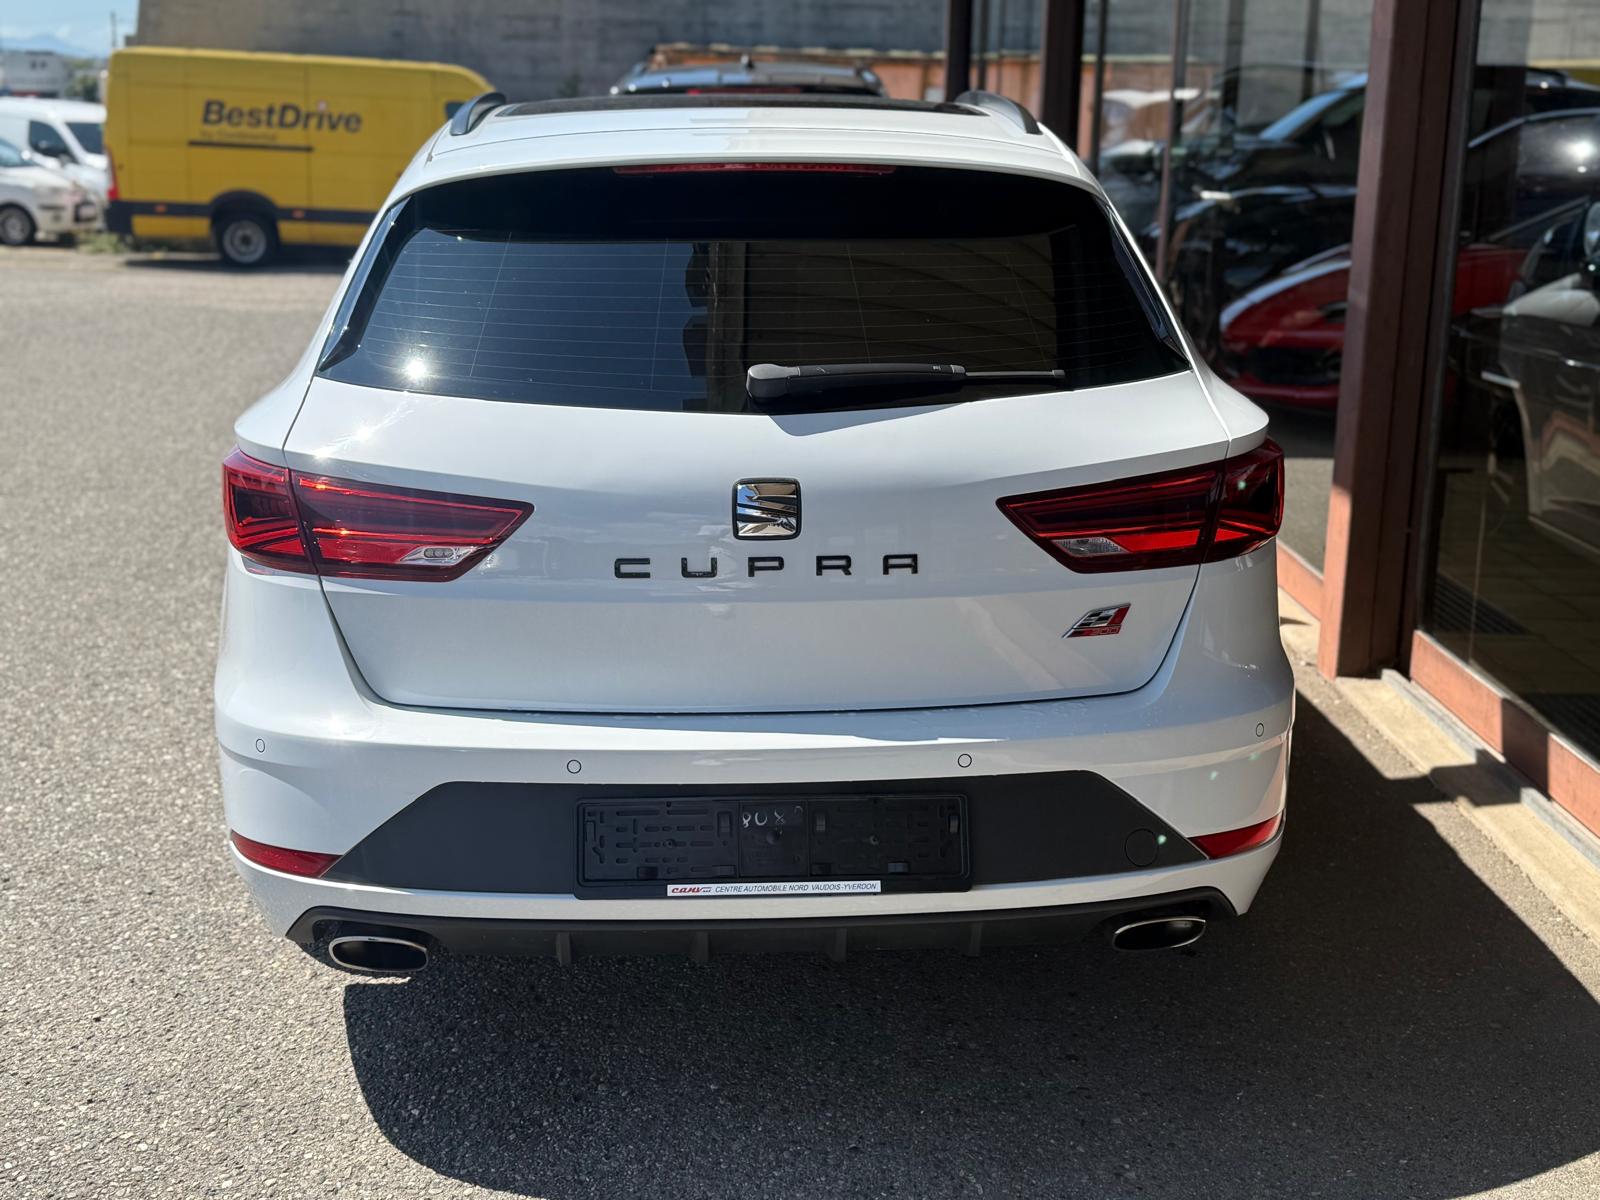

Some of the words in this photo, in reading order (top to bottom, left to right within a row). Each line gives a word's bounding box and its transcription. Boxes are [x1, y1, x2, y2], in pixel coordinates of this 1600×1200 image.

[202, 99, 363, 133] BestDrive
[614, 553, 919, 579] CUPRA
[743, 884, 787, 893] AUTOMOBILE
[788, 884, 809, 892] NORD
